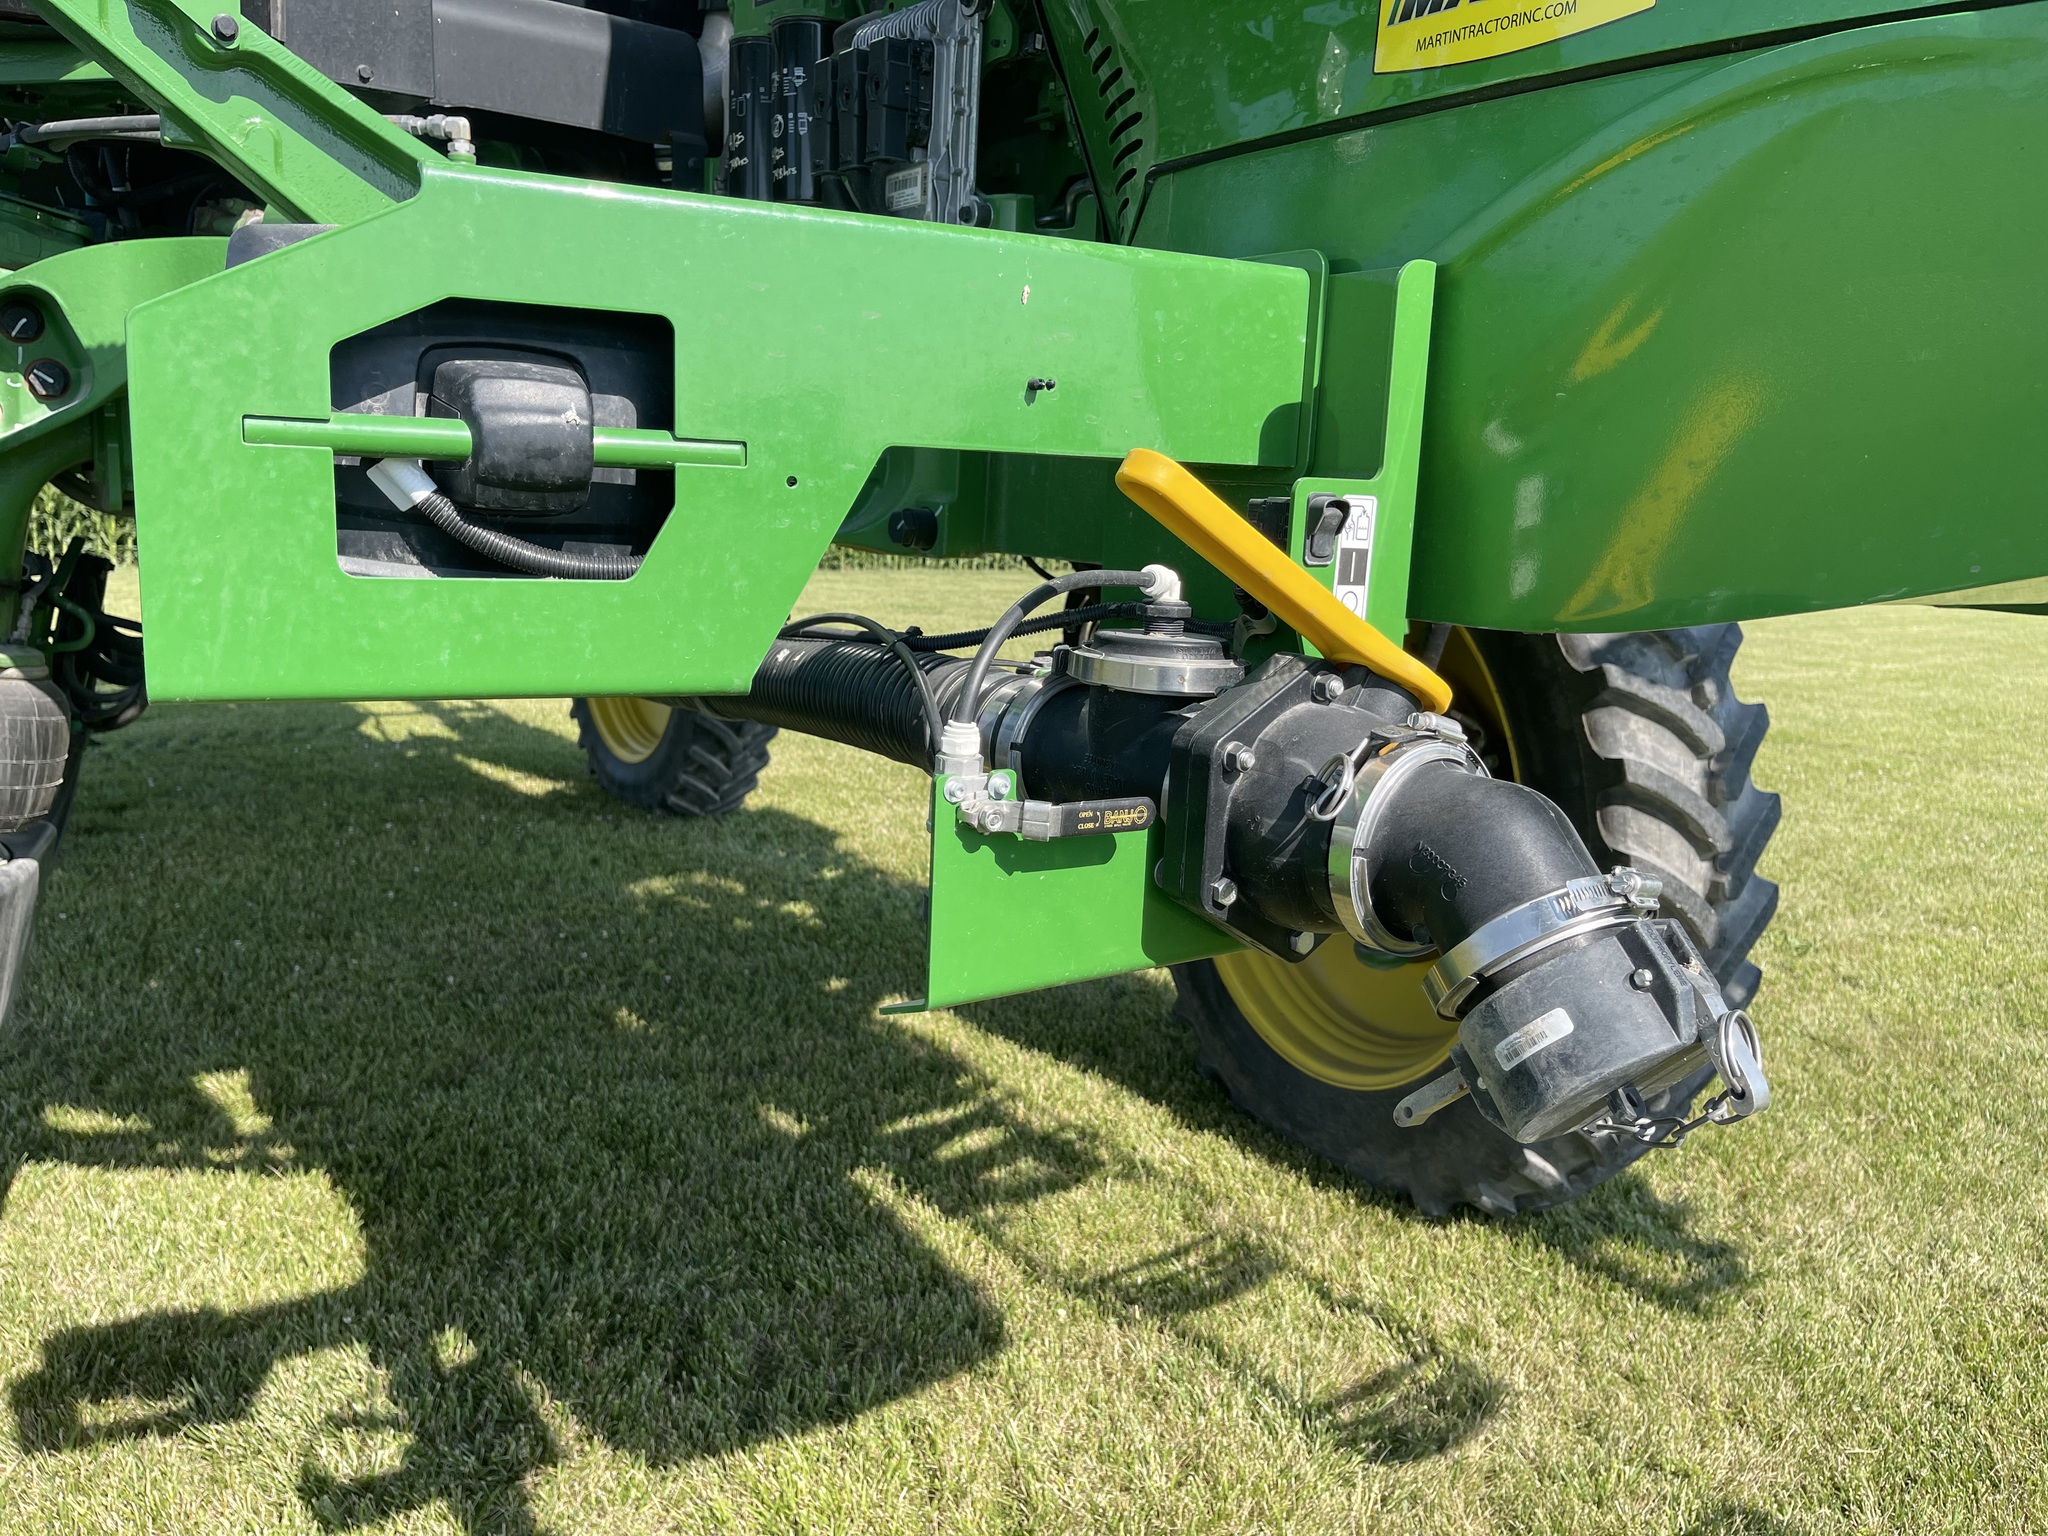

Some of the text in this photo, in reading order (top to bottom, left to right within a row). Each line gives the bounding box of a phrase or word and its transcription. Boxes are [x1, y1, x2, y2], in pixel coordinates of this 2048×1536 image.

[1415, 1, 1577, 53] MARTINTRACTORINC.COM
[1078, 810, 1094, 818] OPEN
[1104, 805, 1148, 826] BANJO
[1077, 822, 1095, 830] CLOSE
[1643, 922, 1689, 988] POLYPROPYLENE
